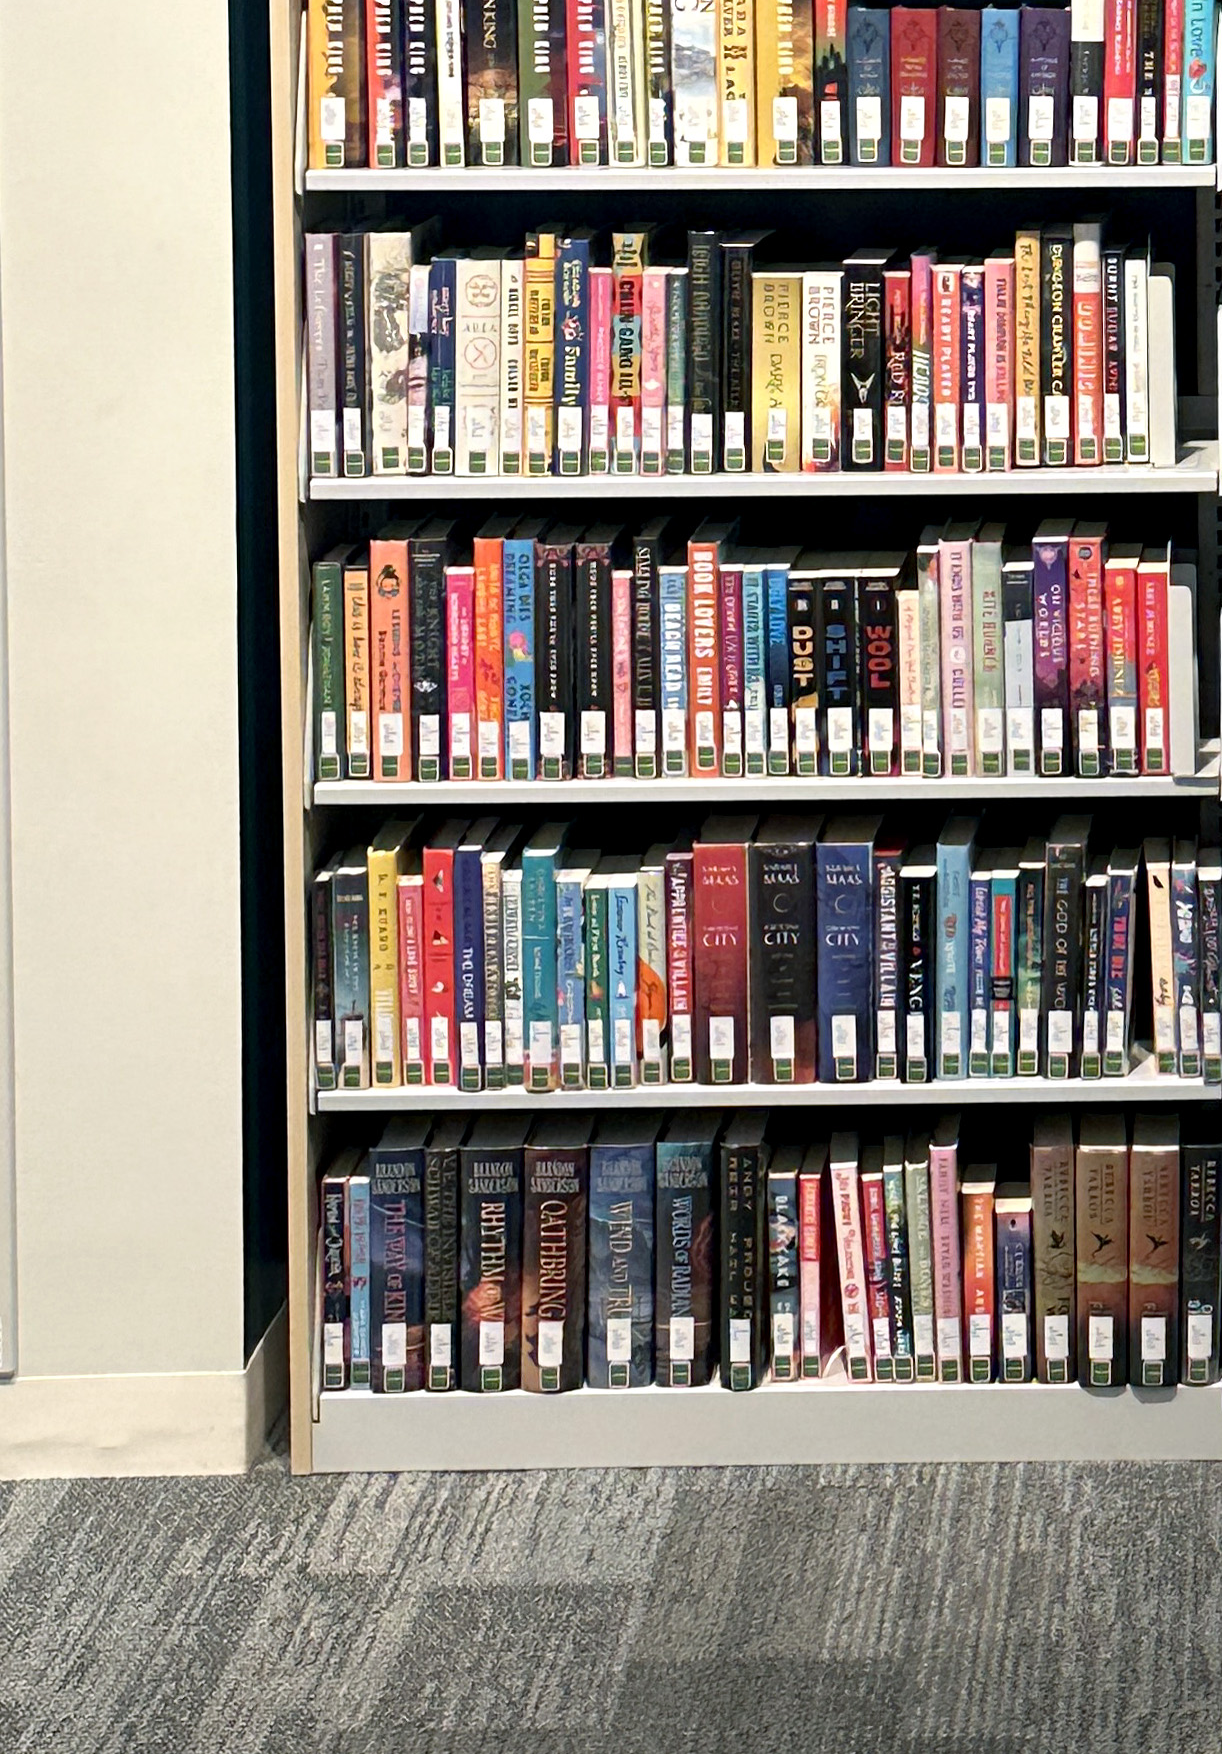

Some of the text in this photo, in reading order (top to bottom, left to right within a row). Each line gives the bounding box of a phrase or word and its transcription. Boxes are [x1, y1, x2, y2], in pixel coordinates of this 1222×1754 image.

[482, 11, 496, 49] KING
[1190, 18, 1207, 57] Love
[327, 41, 343, 74] KING
[376, 43, 391, 76] KING
[409, 42, 425, 74] KING
[534, 40, 550, 73] KING
[313, 259, 324, 284] The
[808, 286, 820, 345] BROWN
[822, 286, 835, 345] PIERCE
[845, 282, 864, 359] BRINGER
[865, 282, 880, 336] LIGHT
[1049, 244, 1064, 378] DUNGEON CRAWLER
[561, 345, 580, 405] Family
[505, 553, 515, 624] DREAMING
[519, 554, 529, 588] OLGA
[693, 552, 715, 658] BOOK LOVERS
[664, 603, 681, 691] BEACH READ
[792, 625, 814, 687] DUST
[866, 624, 893, 690] WOOL
[702, 933, 738, 947] CITY
[763, 931, 800, 946] CITY
[825, 933, 860, 947] CITY
[1056, 899, 1067, 933] GOD
[743, 1157, 753, 1211] ANDY
[1205, 1161, 1216, 1222] REBECCA
[481, 1202, 505, 1281] RHYTHM
[609, 1201, 633, 1253] WIND
[671, 1196, 692, 1248] WORDS
[384, 1237, 406, 1271] WAY
[539, 1200, 567, 1318] OATHBRING
[975, 1225, 985, 1278] MARTIAN
[384, 1291, 406, 1322] KIN
[607, 1284, 632, 1318] TRU
[671, 1265, 692, 1317] RADIAN
